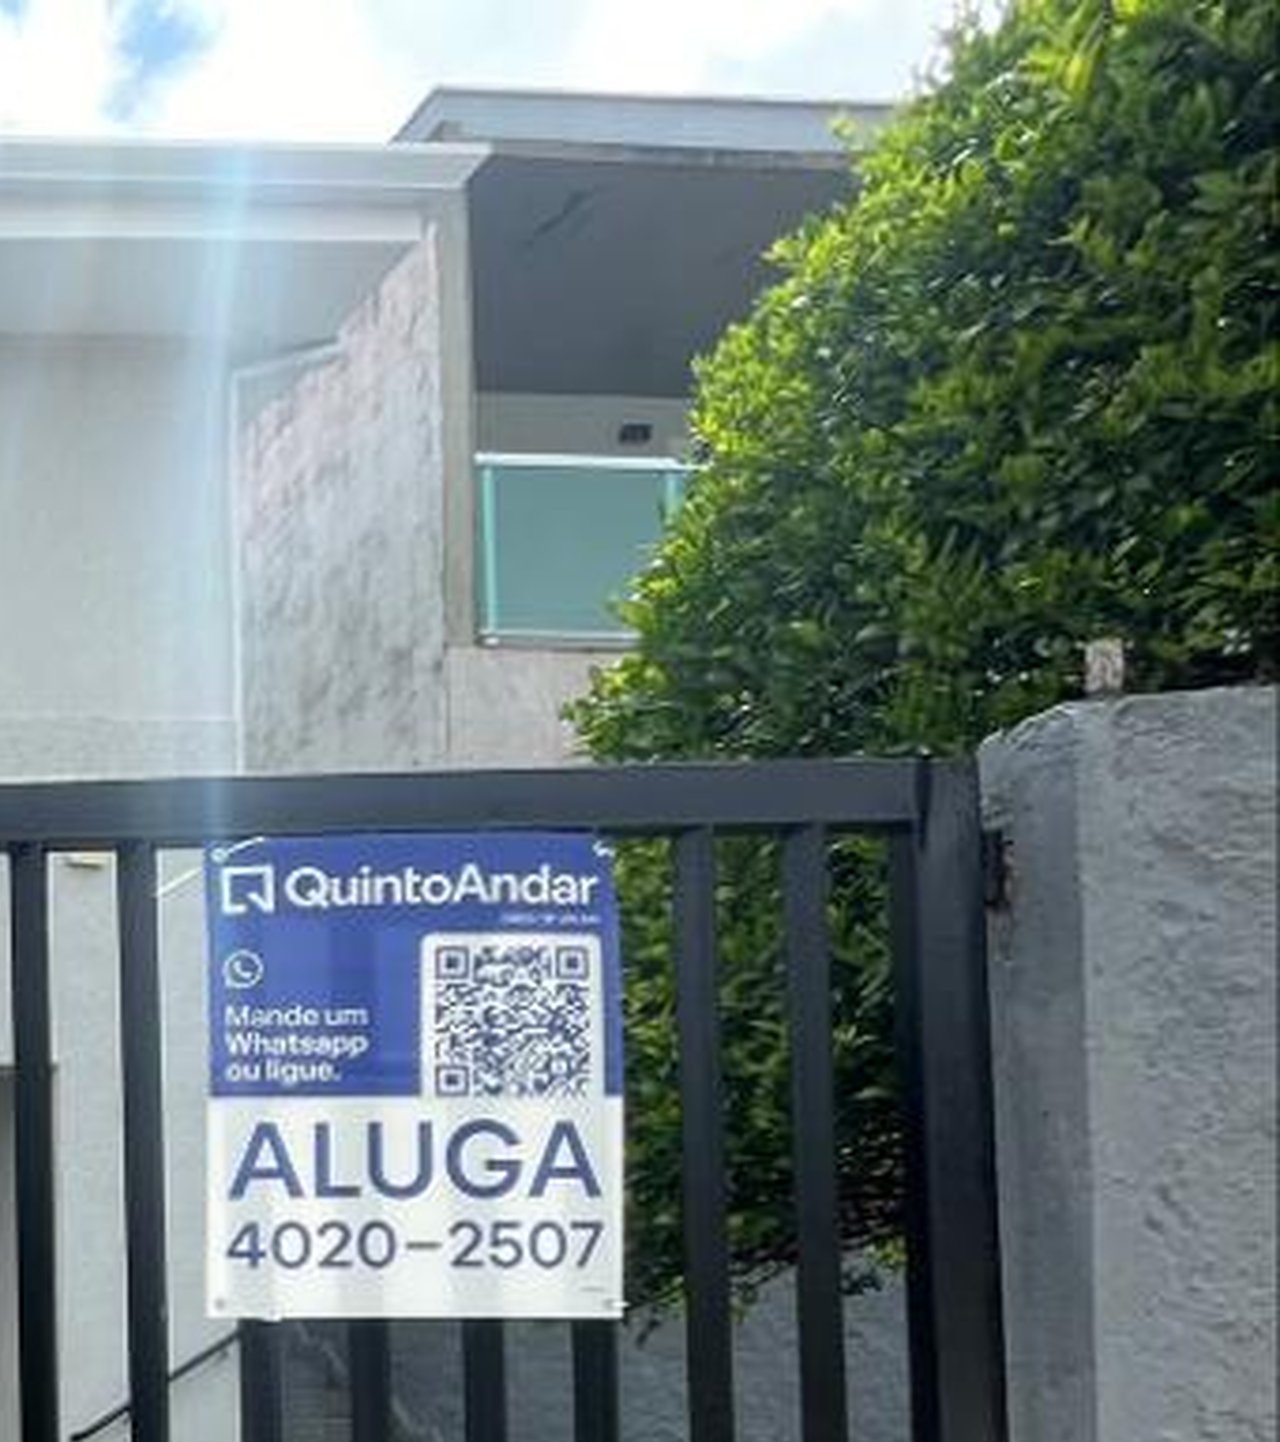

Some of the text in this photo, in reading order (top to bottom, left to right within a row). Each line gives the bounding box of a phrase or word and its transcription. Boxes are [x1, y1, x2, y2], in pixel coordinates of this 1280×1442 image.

[284, 863, 599, 908] QuintoAndar
[225, 1004, 369, 1026] Mande um
[225, 1031, 370, 1058] Whatsapp
[225, 1060, 342, 1088] ou ligue.
[227, 1119, 602, 1199] ALUGA
[226, 1220, 606, 1269] 4020-2507
